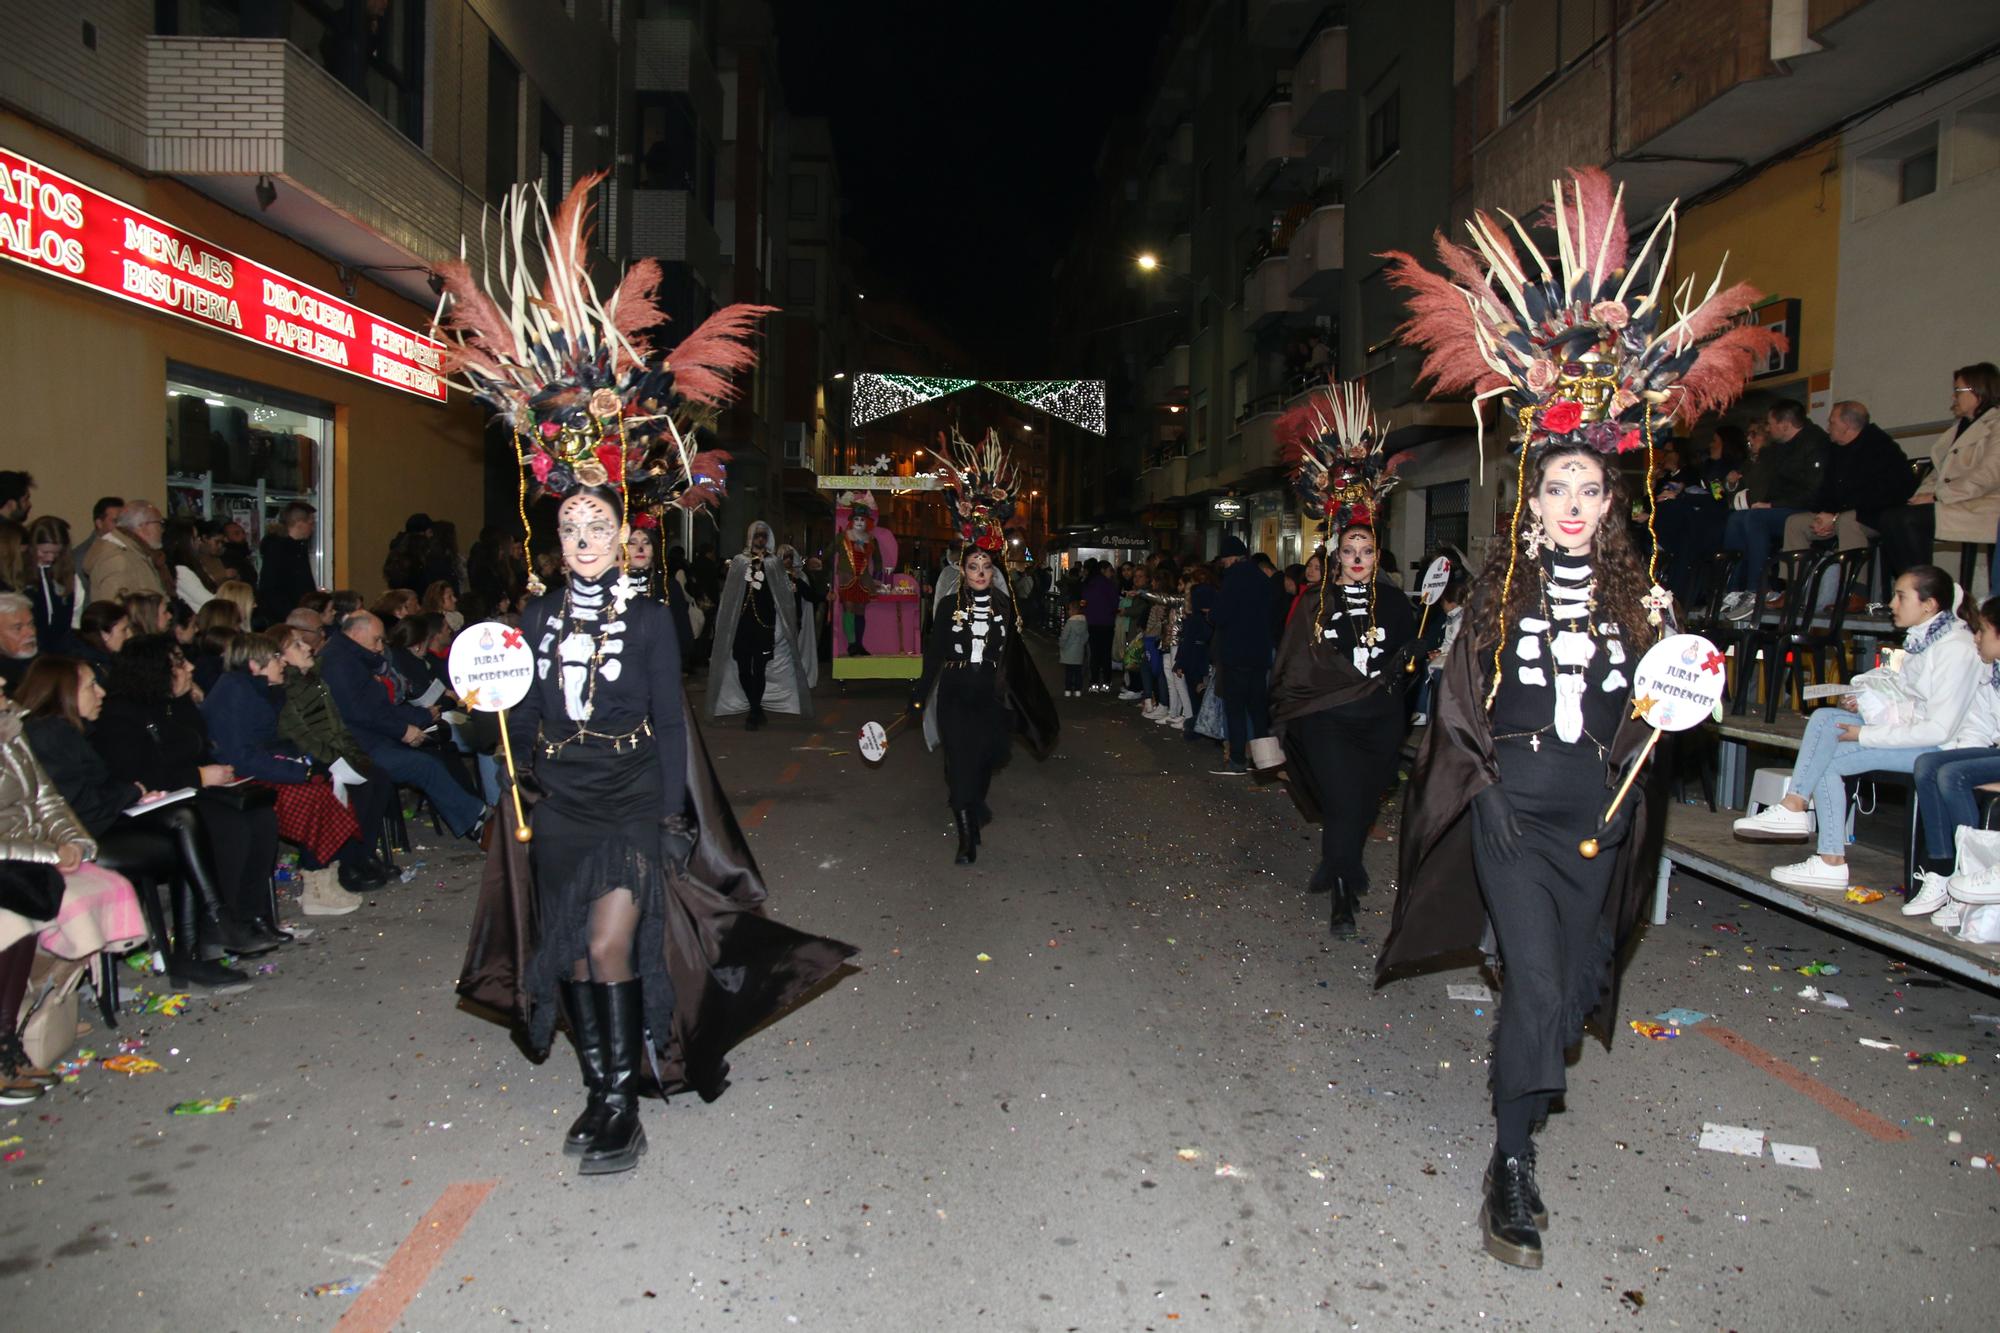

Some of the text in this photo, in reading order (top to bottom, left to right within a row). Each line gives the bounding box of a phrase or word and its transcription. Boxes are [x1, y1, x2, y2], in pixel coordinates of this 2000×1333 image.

[124, 217, 234, 289] MENAJES
[262, 278, 356, 339] DROGUERIA
[123, 258, 243, 329] BISUTERIA
[265, 314, 349, 366] PAPELERIA
[372, 352, 440, 396] FERRETERIA
[474, 654, 505, 665] JURAT
[468, 667, 530, 682] INCIDENCIES
[1666, 665, 1700, 683] JURAT
[1652, 680, 1714, 706] INCIDENCIES
